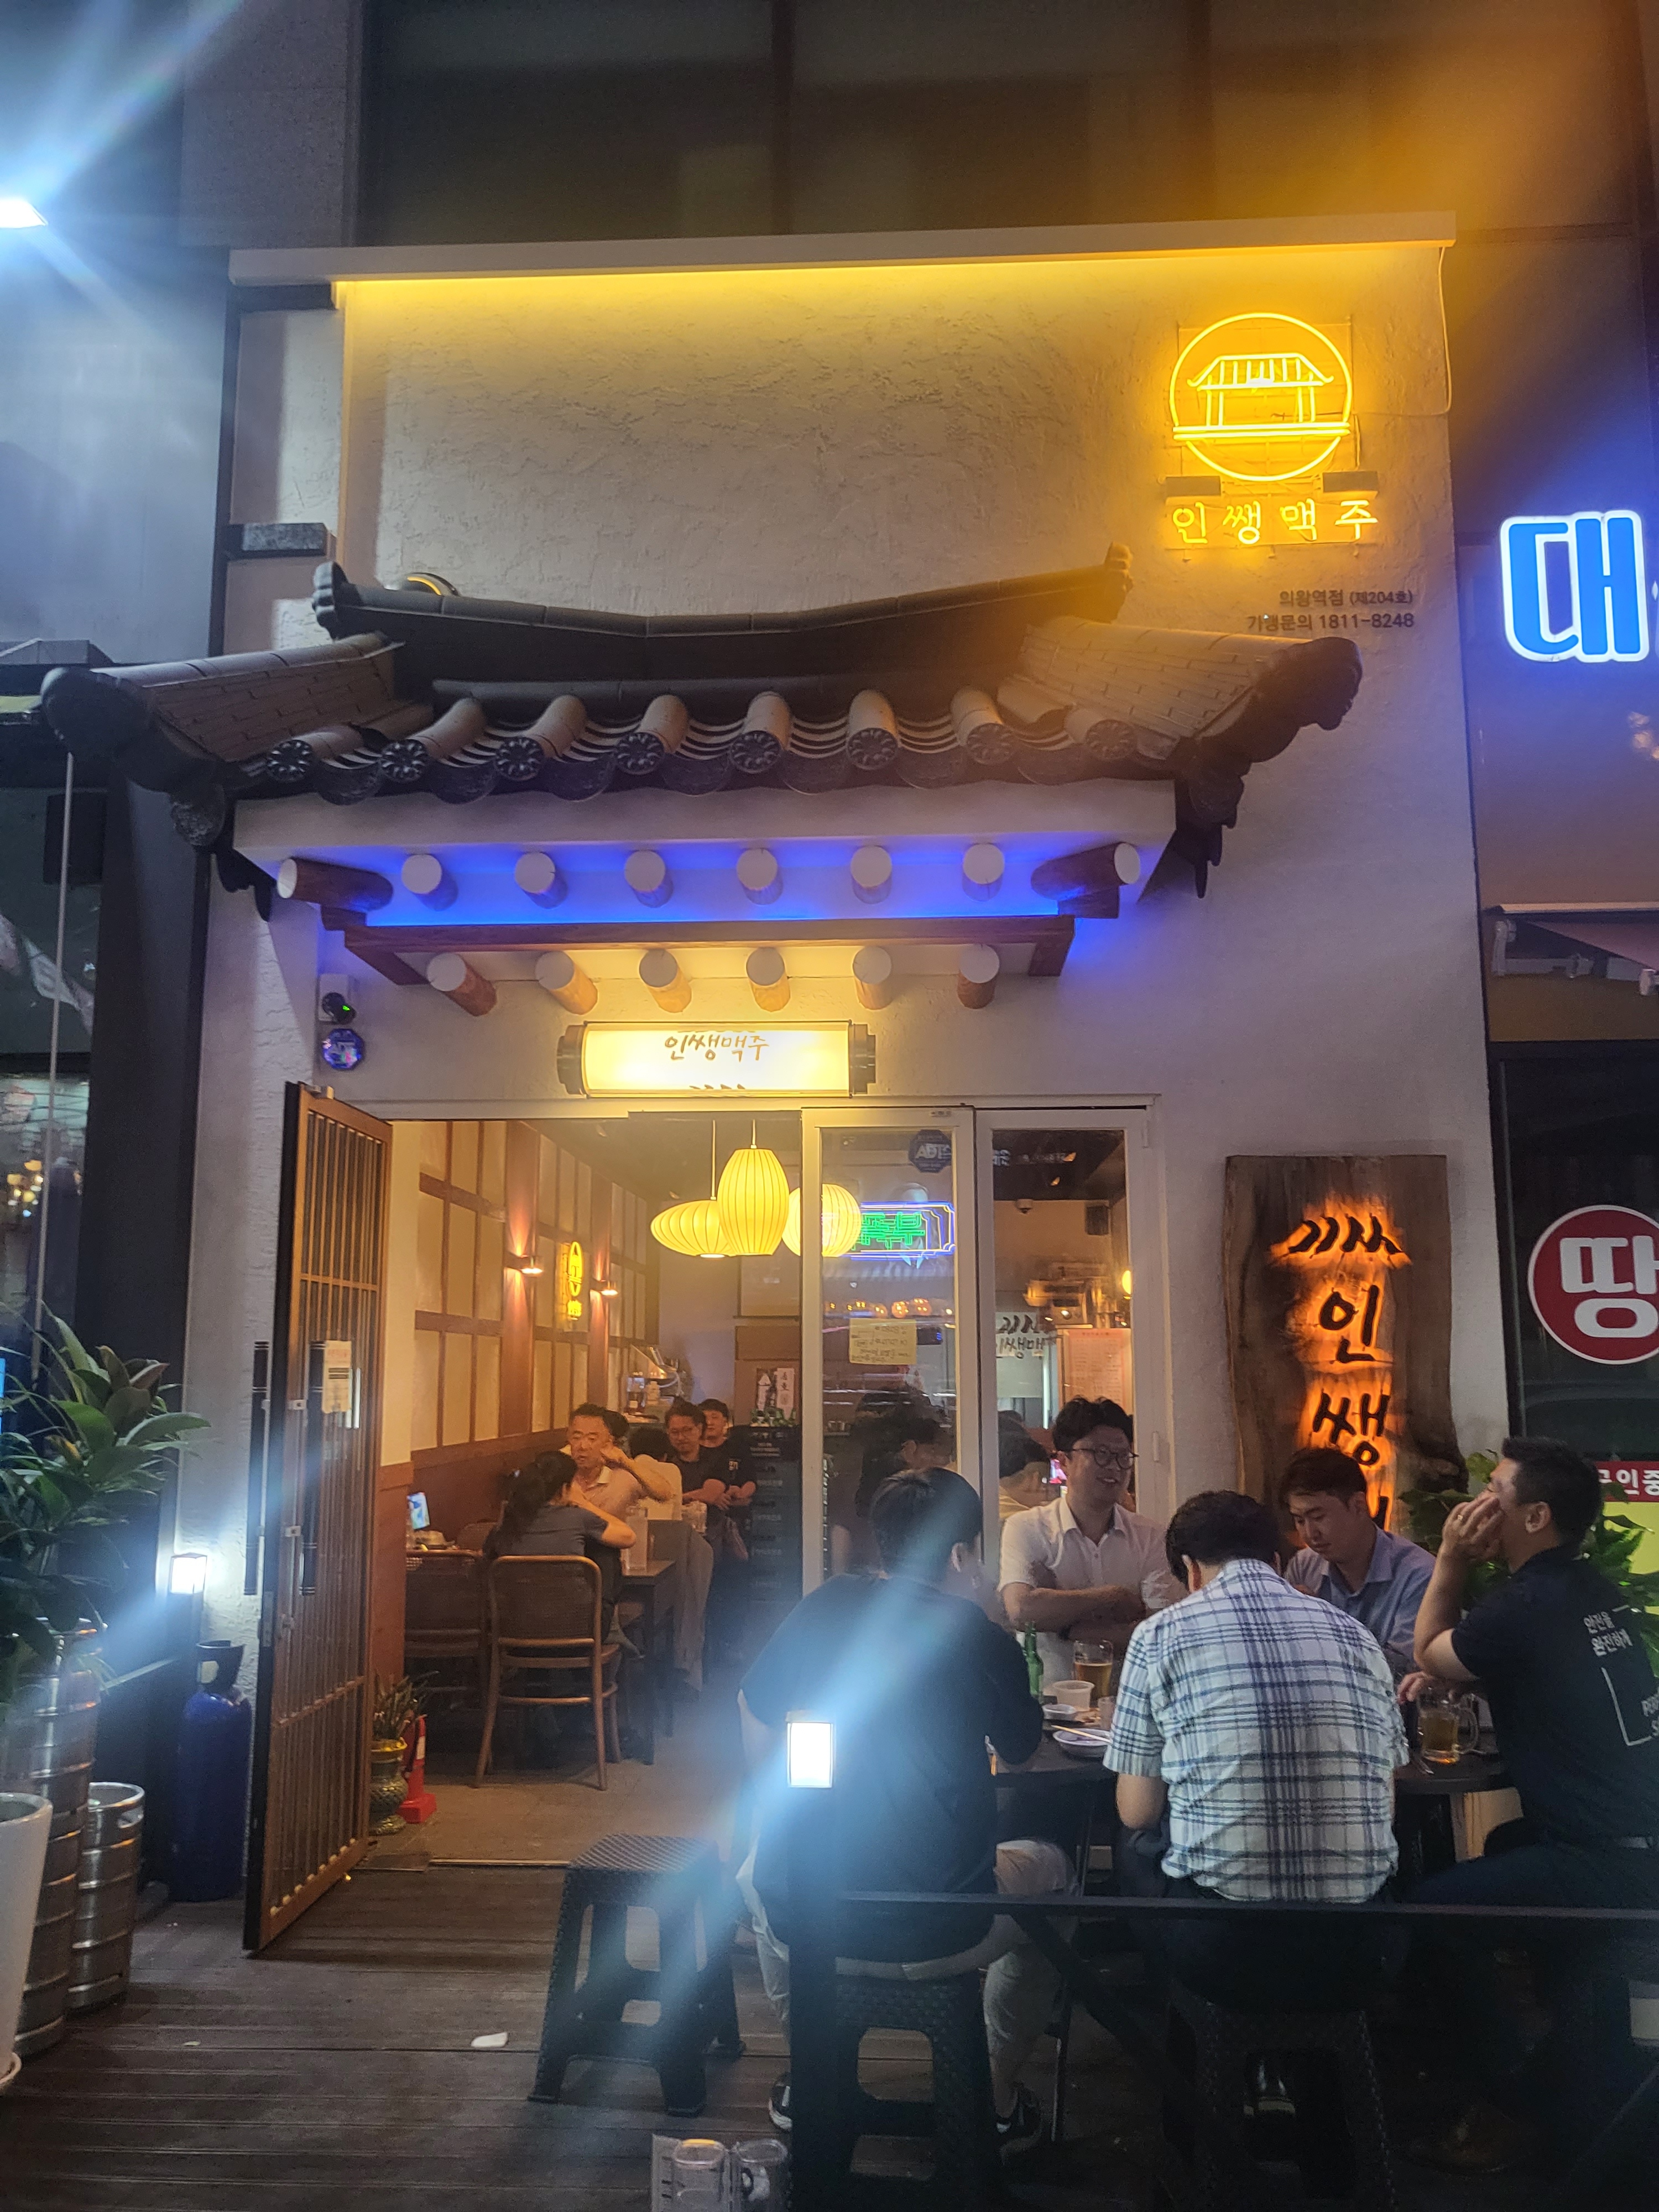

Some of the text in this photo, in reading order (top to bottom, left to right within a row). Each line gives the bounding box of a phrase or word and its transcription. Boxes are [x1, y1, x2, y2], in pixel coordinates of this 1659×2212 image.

[1172, 498, 1379, 545] 인쌩맥주
[1279, 589, 1413, 607] 의왕역점 (제204호)
[1248, 613, 1415, 632] 가맹문의 1811-8248
[665, 1034, 769, 1062] 인쌩맥주
[1313, 1284, 1391, 1531] 인쌩
